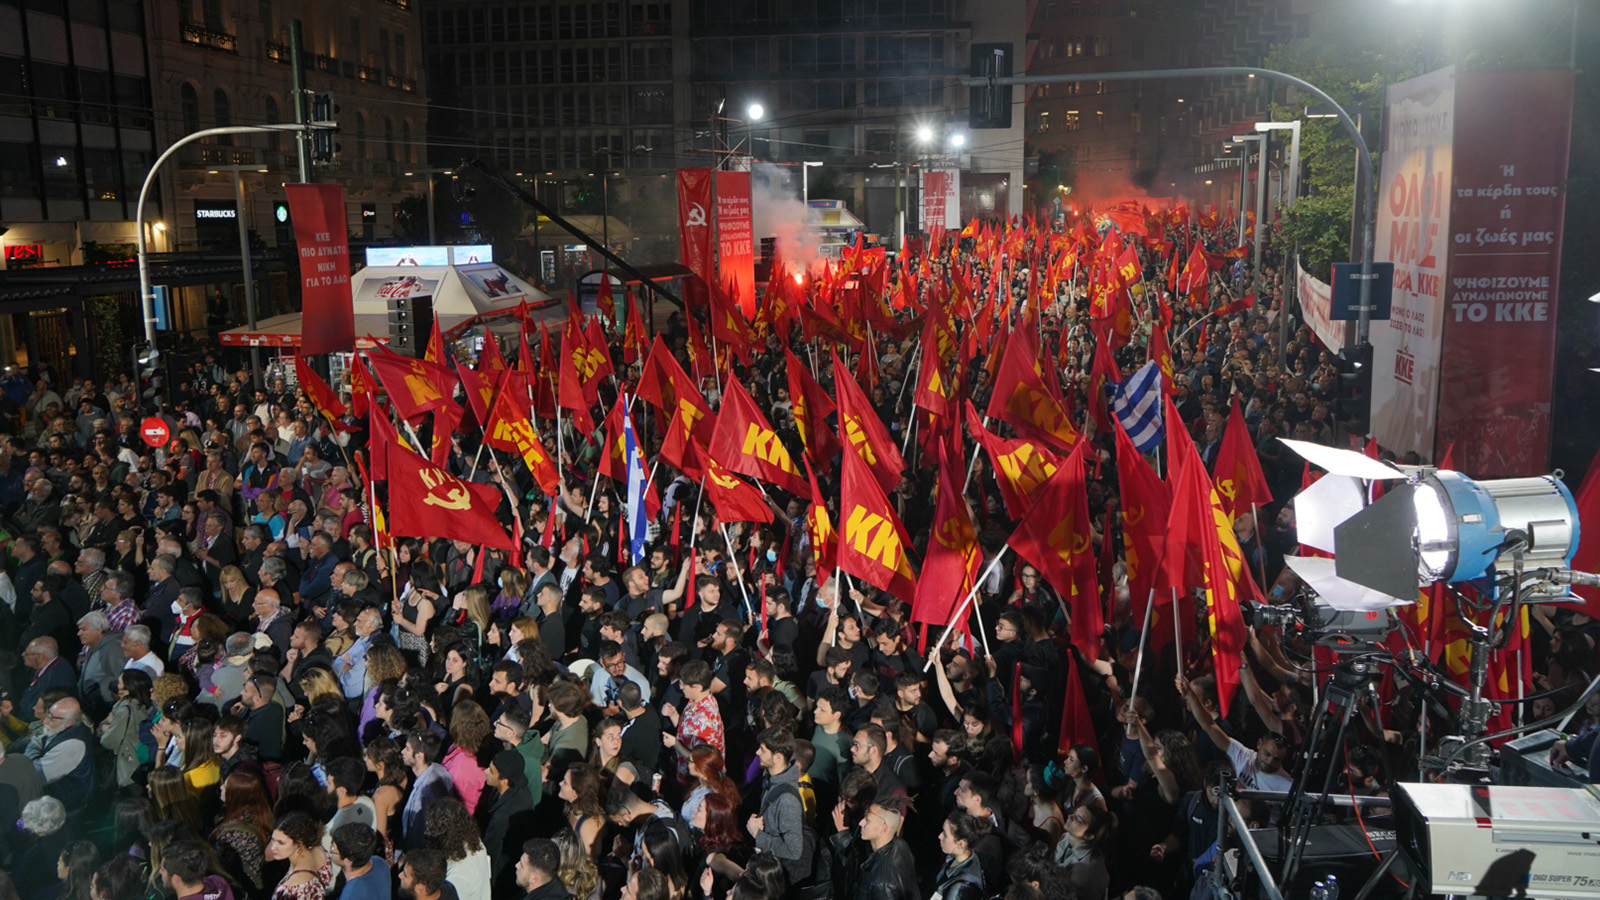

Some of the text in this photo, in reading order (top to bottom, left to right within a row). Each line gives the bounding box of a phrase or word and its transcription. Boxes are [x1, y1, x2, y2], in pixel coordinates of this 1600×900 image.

[1390, 171, 1443, 218] ΟΛΟΙ
[1457, 184, 1558, 200] τα κέρδη τους
[197, 210, 235, 218] STARBUCKS
[1500, 204, 1511, 219] ή
[315, 232, 331, 242] ΚΚΕ
[1455, 227, 1554, 246] οι ζωές μας
[301, 245, 347, 257] ΠΙΟ ΔΥΝΑΤΟ
[1389, 221, 1439, 269] ΜΑΣ
[317, 262, 336, 272] ΝΙΚΗ
[306, 277, 320, 288] ΓΙΑ
[321, 276, 331, 286] ΤΟ
[1453, 276, 1549, 288] ΨΗΦΙΖΟΥΜΕ
[1453, 291, 1549, 301] ΔΥΝΑΜΩΝΟΥΜΕ
[1452, 302, 1548, 322] ΤΟ ΚΚΕ
[1395, 354, 1414, 380] ΚΚΕ
[1548, 874, 1572, 883] SUPER
[1573, 875, 1588, 887] 75
